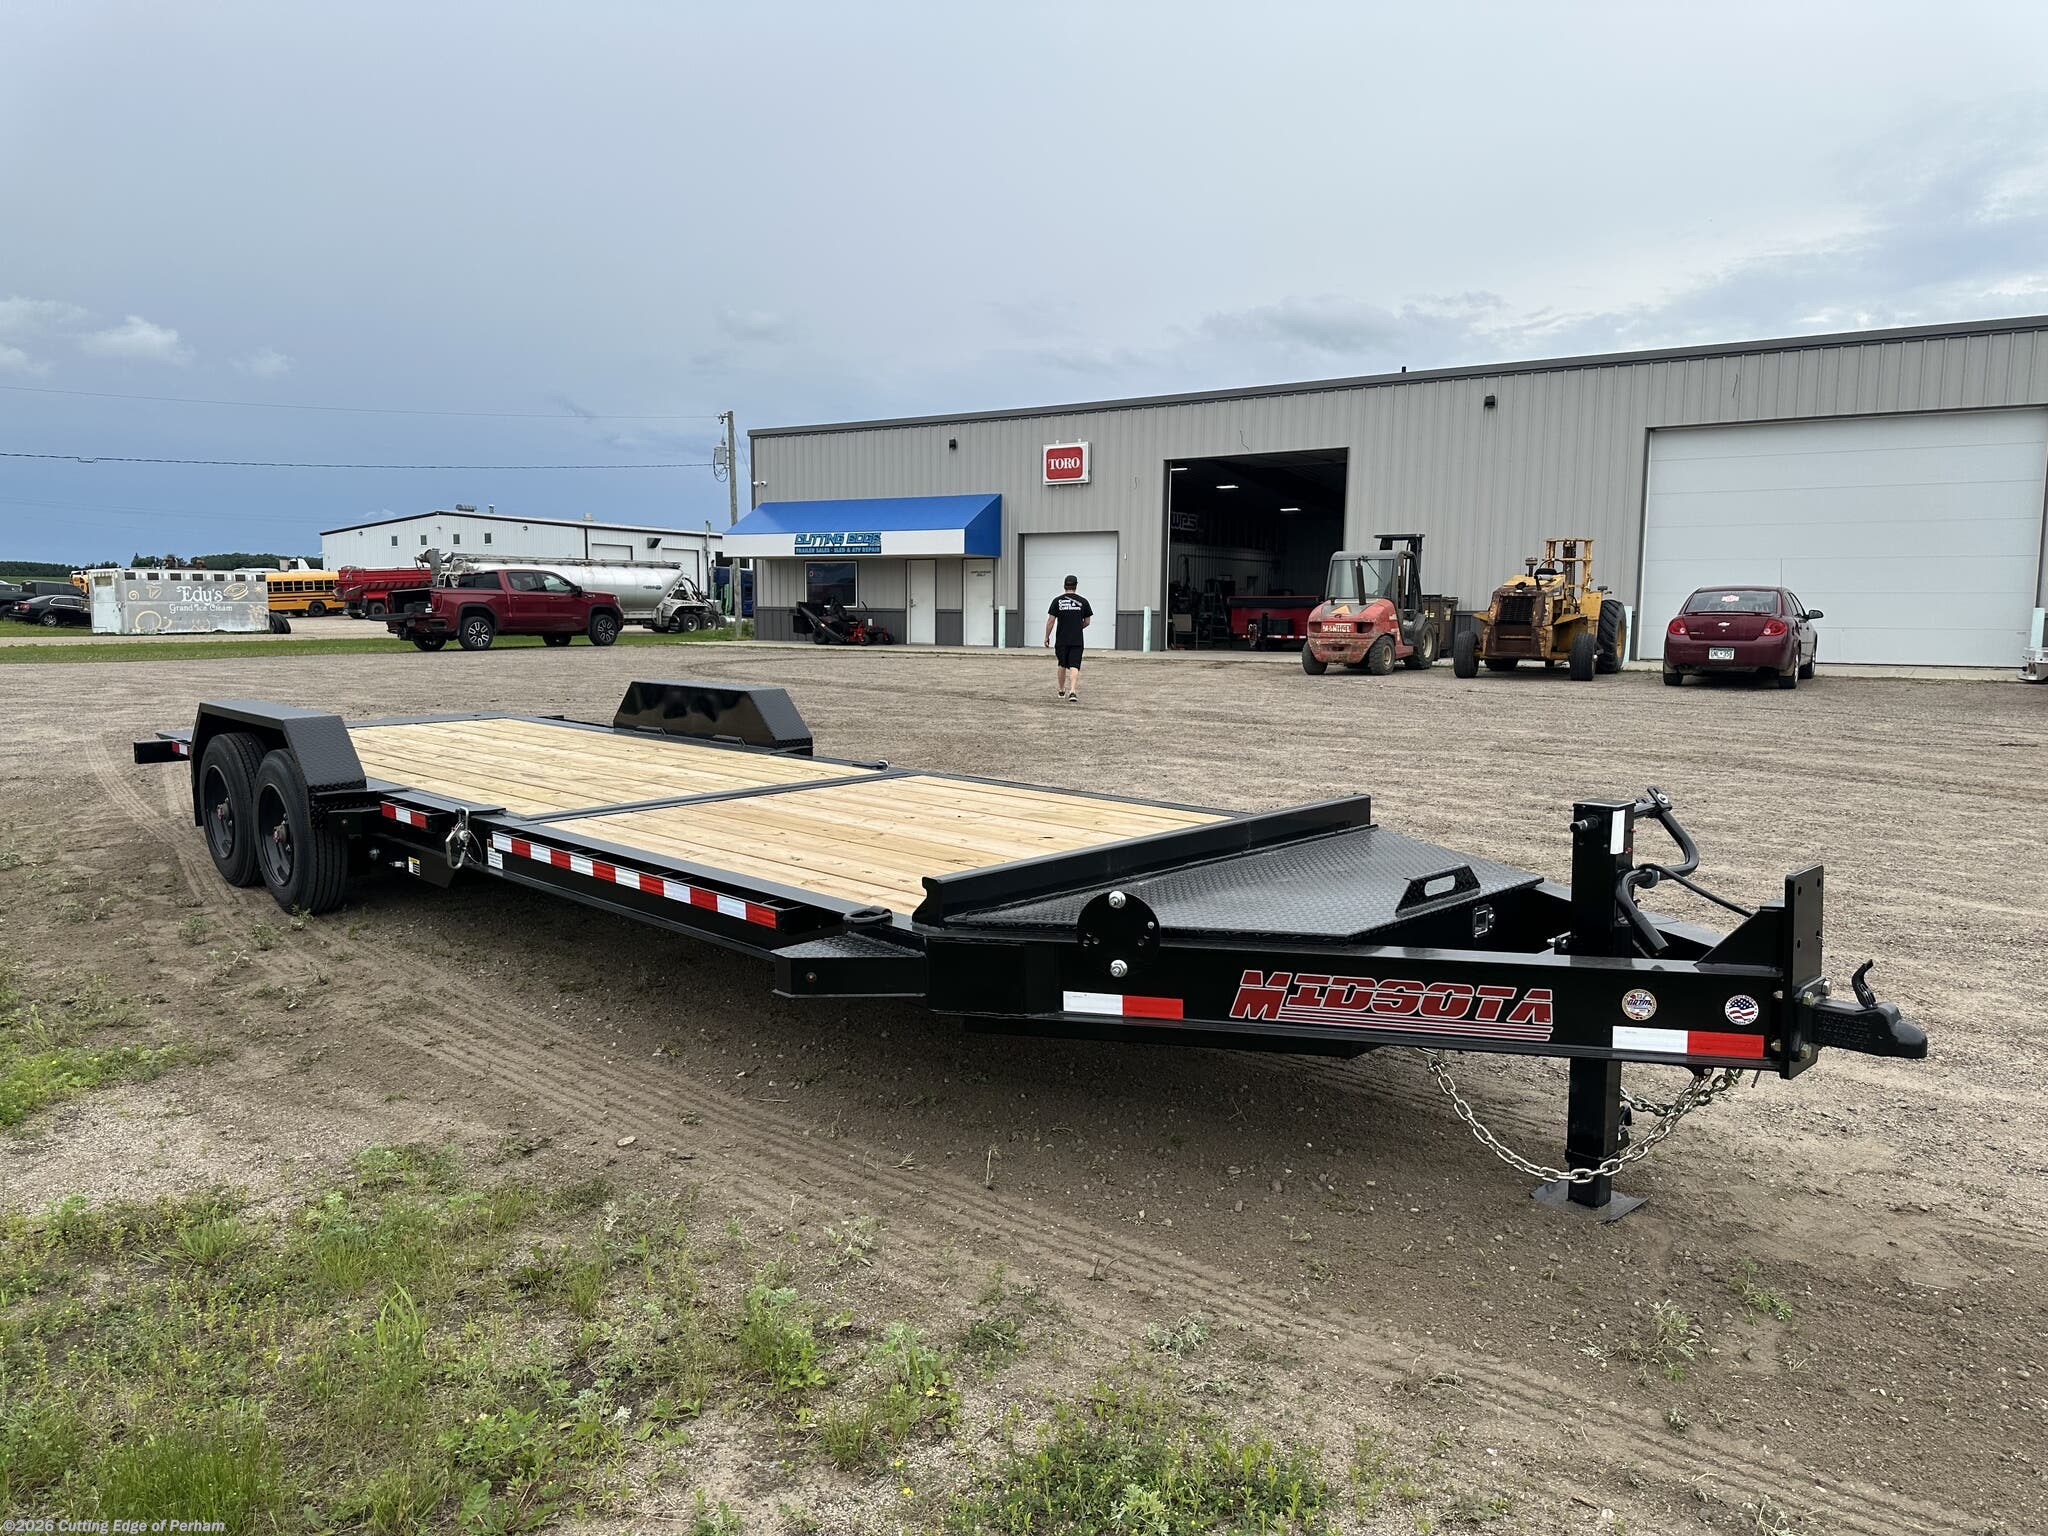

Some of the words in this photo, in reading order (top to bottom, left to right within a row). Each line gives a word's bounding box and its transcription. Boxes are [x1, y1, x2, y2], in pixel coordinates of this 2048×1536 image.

[1048, 457, 1080, 470] TORO
[795, 533, 844, 546] CUTTING
[847, 532, 881, 545] EDGE
[176, 585, 224, 606] Edy's
[169, 603, 194, 614] Grand
[194, 603, 208, 612] Ice
[209, 603, 233, 612] Cream
[1229, 970, 1553, 1025] MIDSOTA
